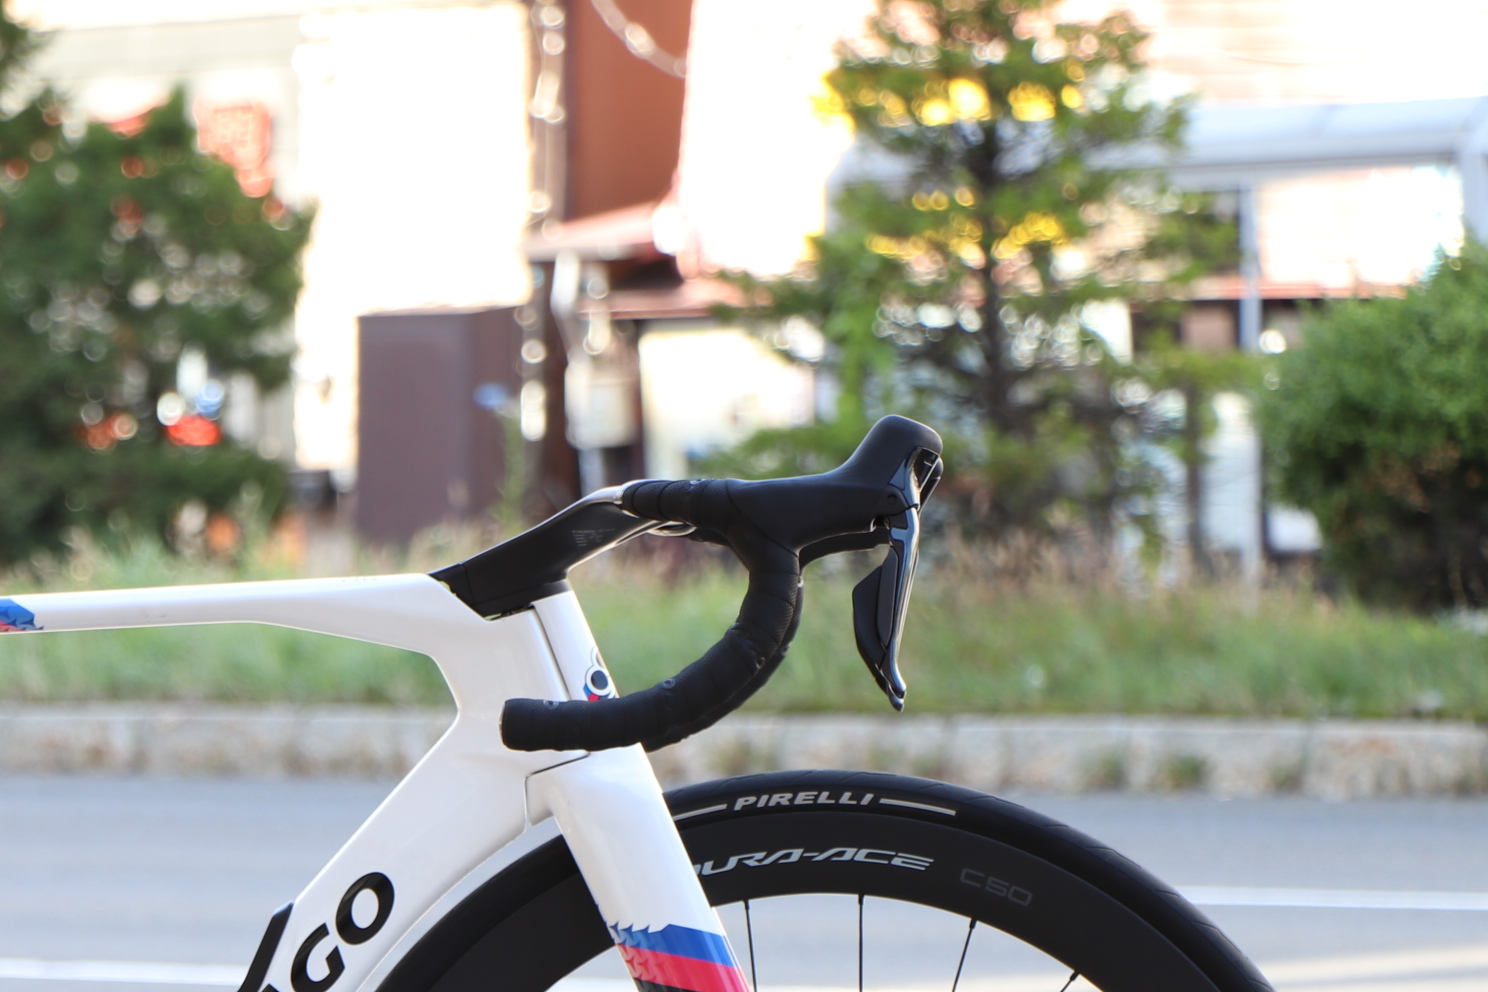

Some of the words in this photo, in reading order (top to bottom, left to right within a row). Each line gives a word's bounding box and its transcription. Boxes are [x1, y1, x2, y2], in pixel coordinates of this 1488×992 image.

[733, 791, 875, 811] PIRELLI
[694, 847, 935, 876] URA-ACE
[959, 868, 1033, 906] C50
